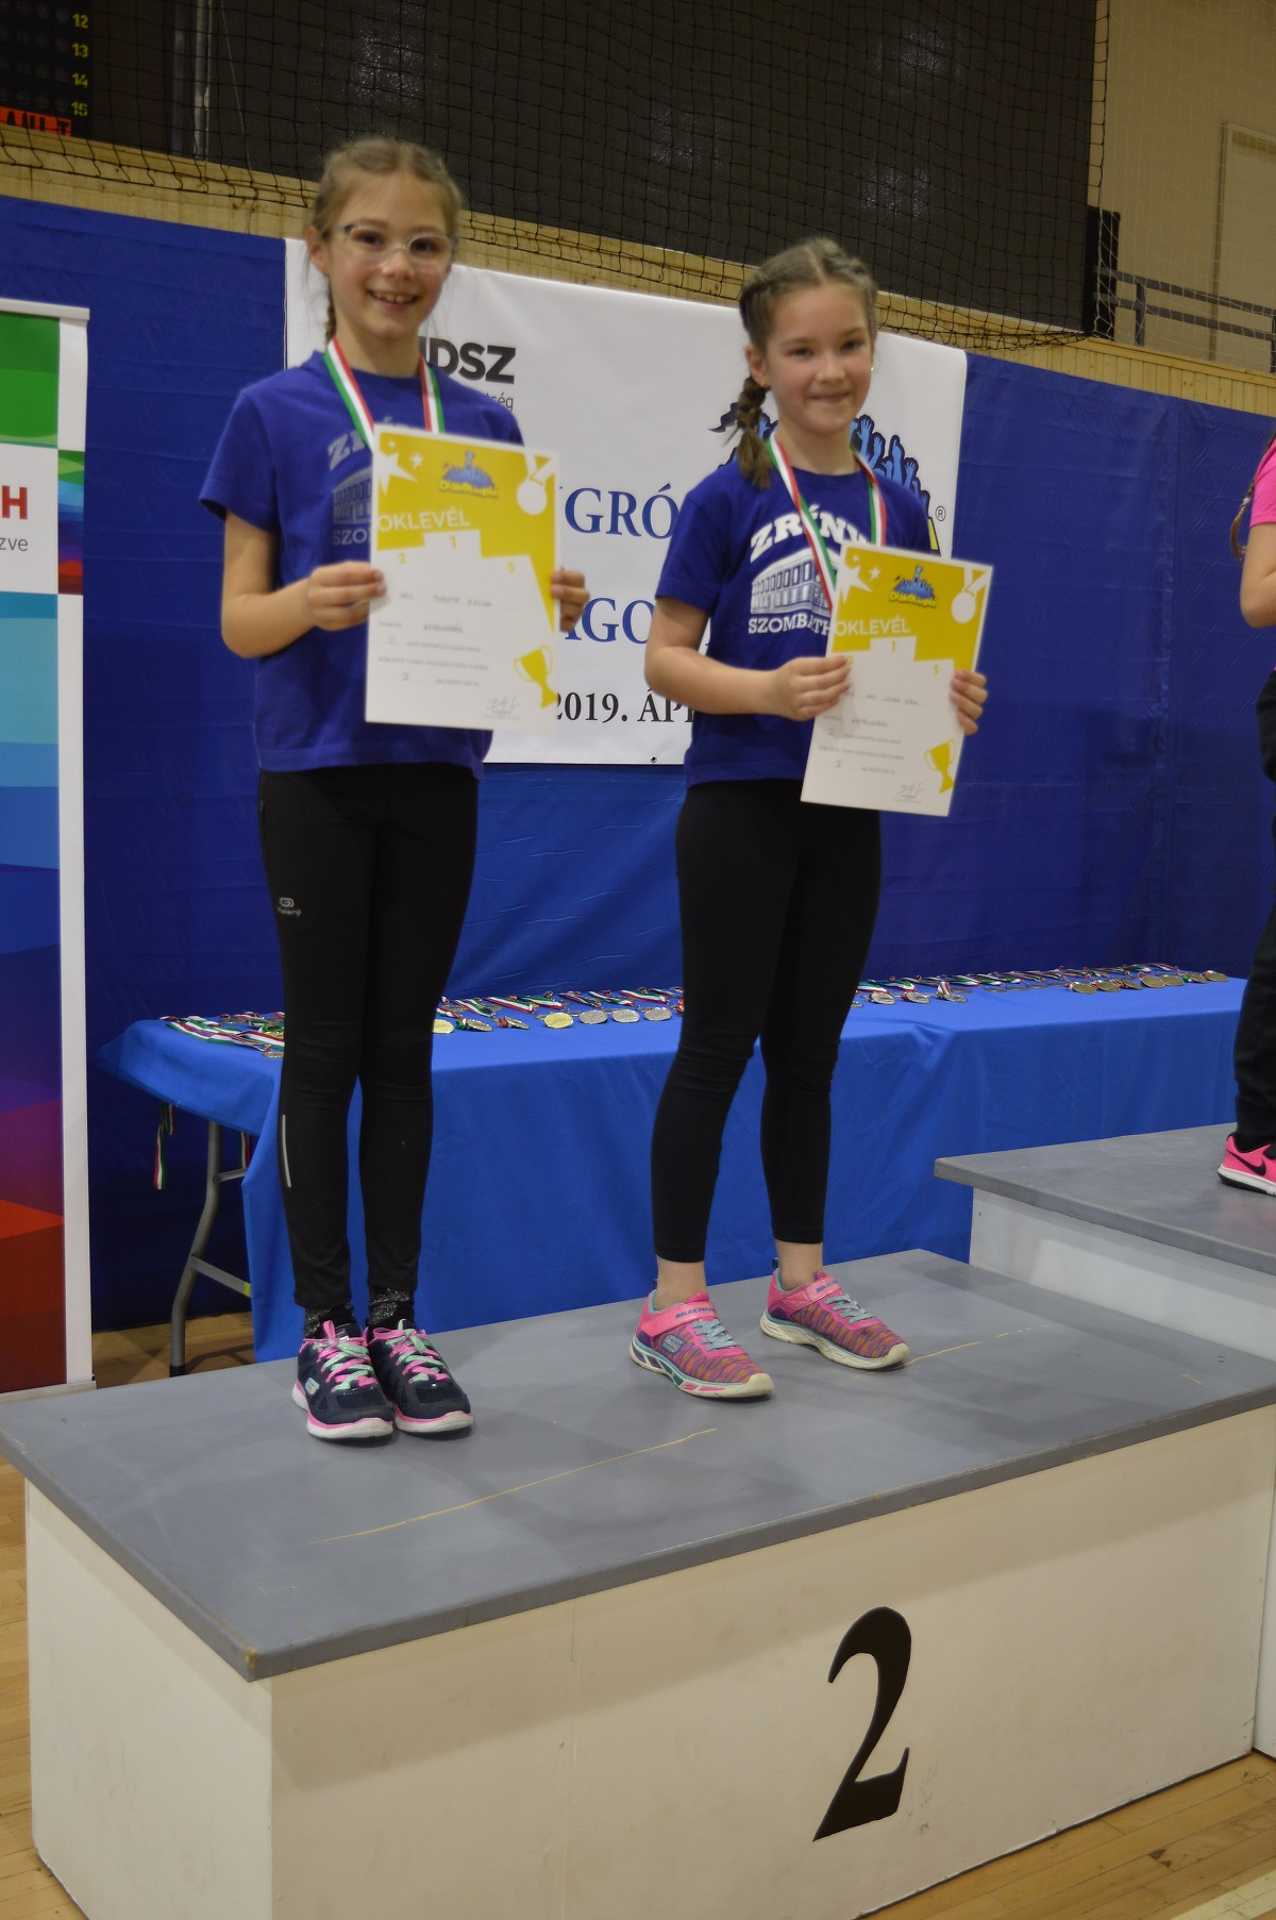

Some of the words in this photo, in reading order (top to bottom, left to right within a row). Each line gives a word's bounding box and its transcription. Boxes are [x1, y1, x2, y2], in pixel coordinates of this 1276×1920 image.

[72, 14, 89, 29] 12
[71, 43, 89, 58] 13
[71, 73, 89, 88] 14
[71, 101, 88, 117] 15
[419, 335, 516, 385] DSZ
[2, 485, 28, 520] H
[378, 505, 471, 532] OKLEVÉL
[834, 618, 910, 637] OKLEVÉL
[812, 1606, 912, 1842] 2
